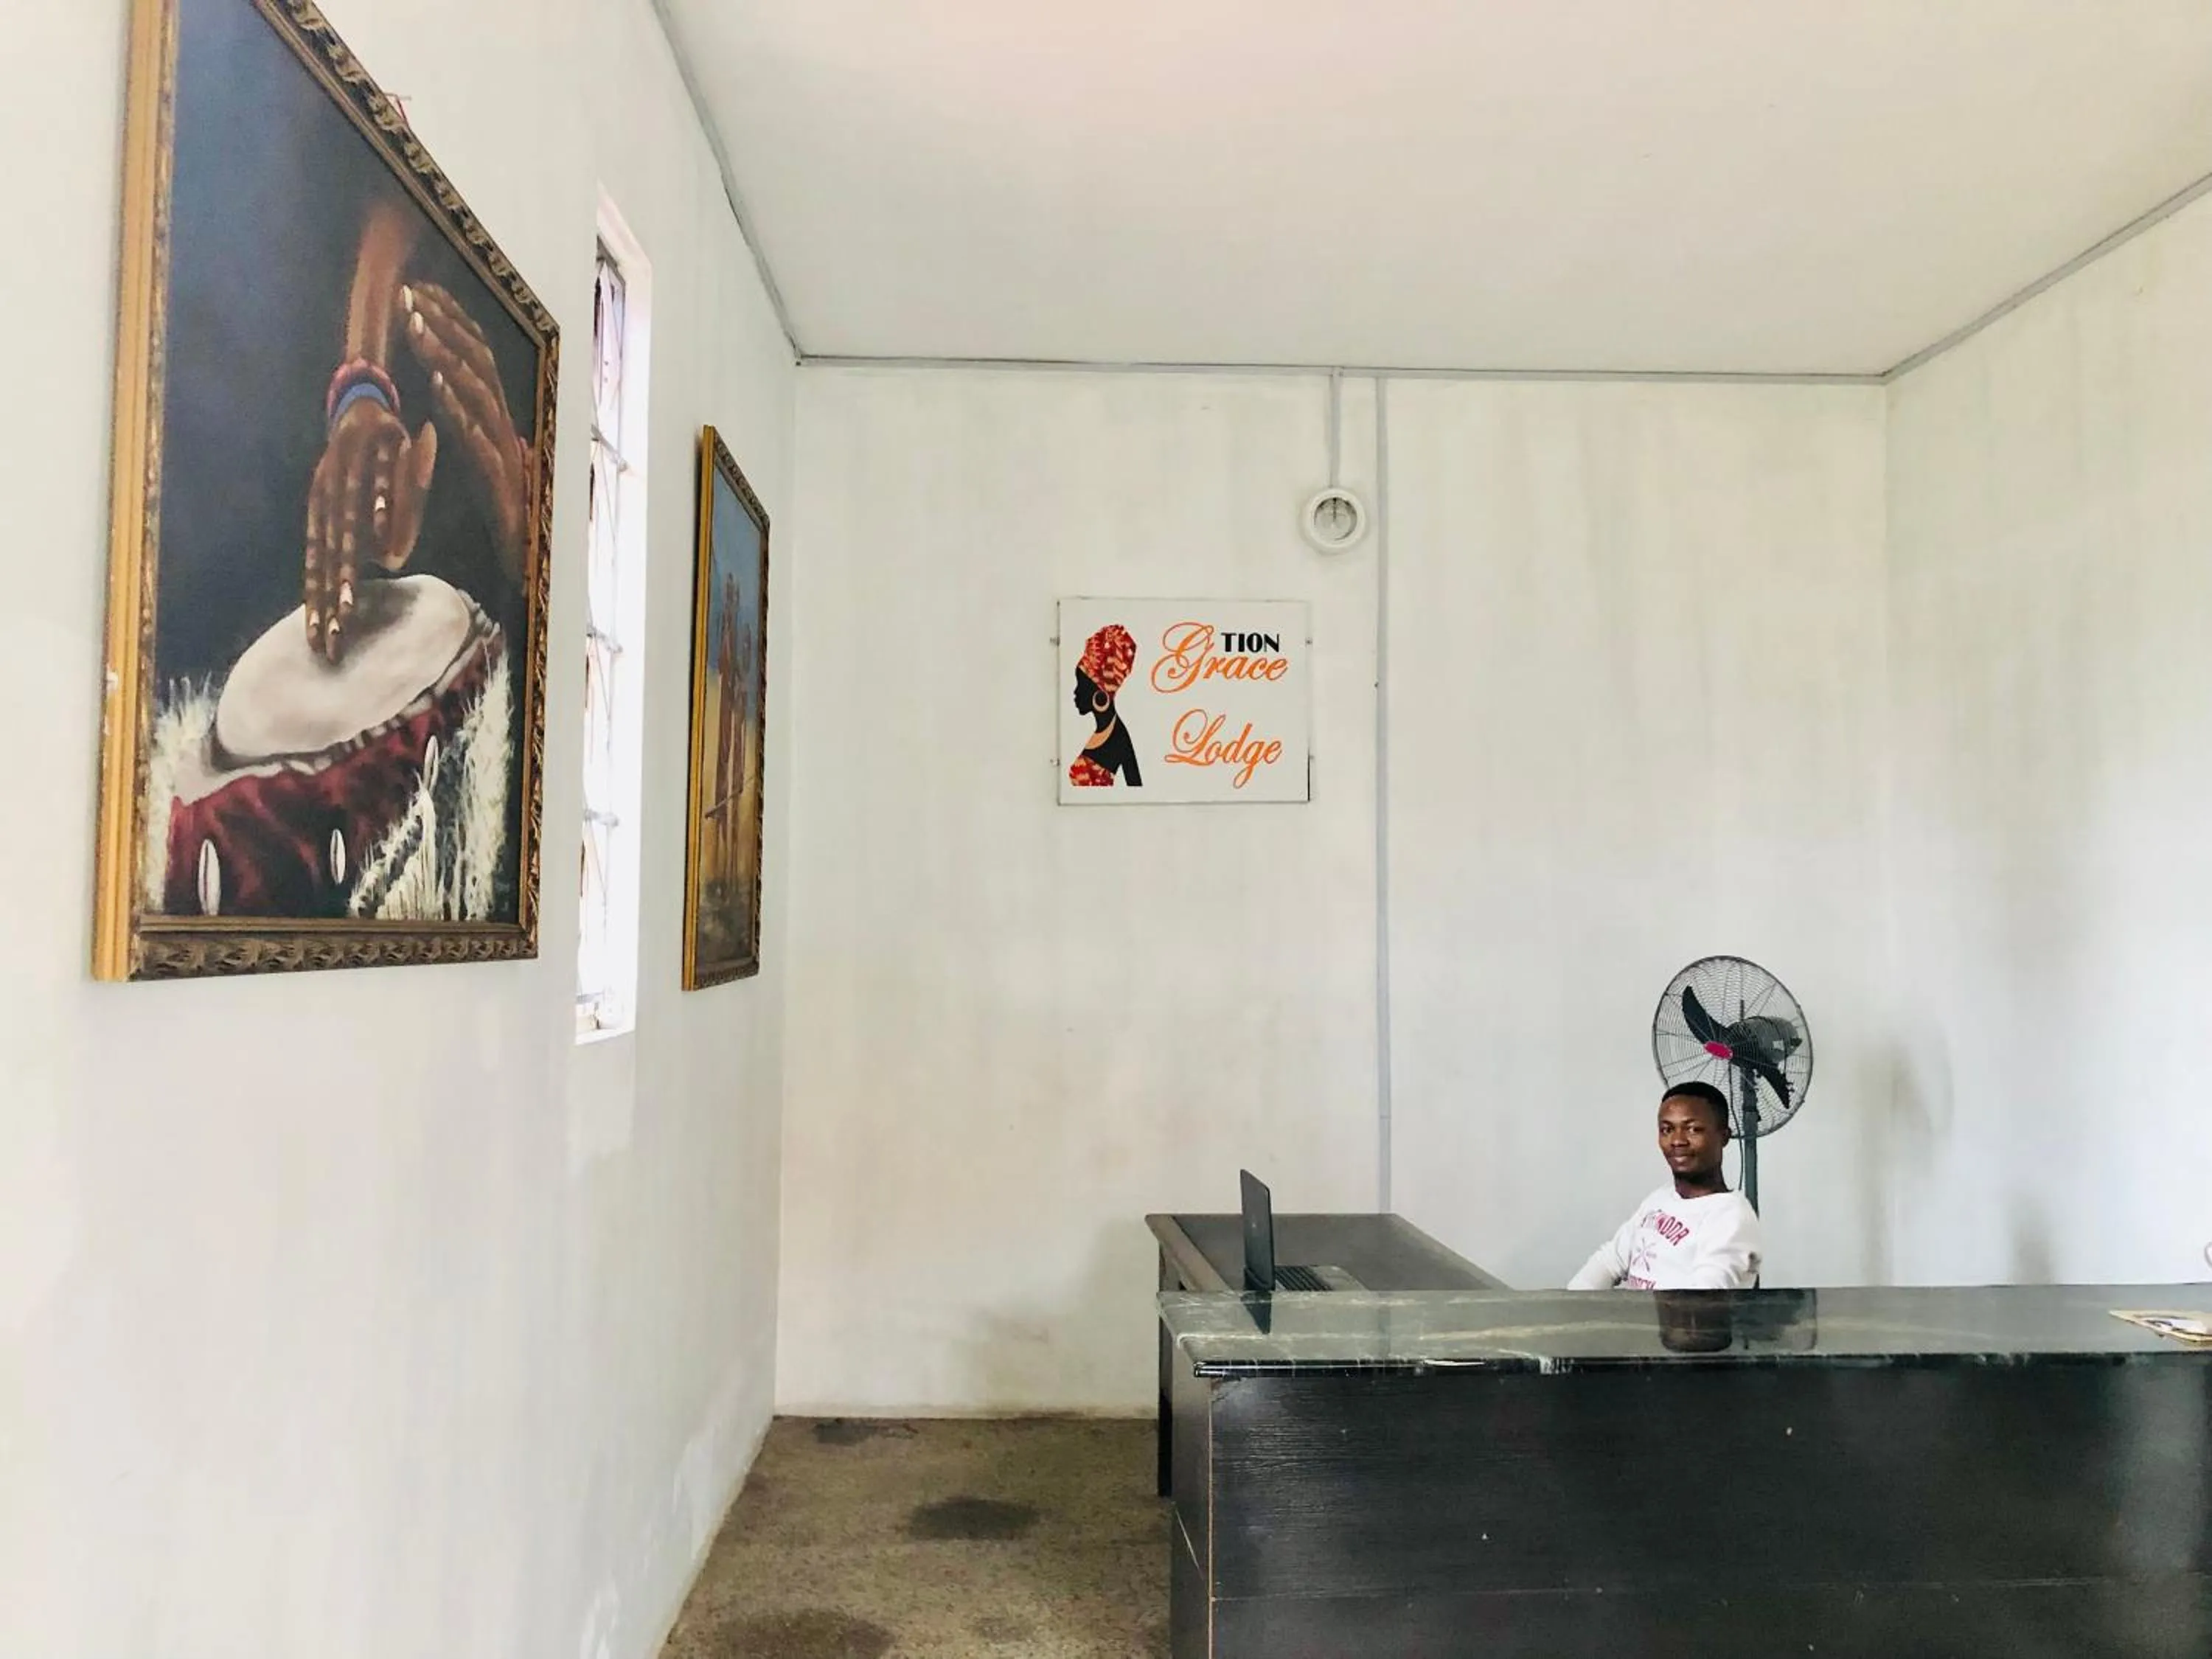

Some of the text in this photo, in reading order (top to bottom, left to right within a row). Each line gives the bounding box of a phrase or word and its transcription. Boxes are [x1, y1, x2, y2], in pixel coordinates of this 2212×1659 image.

[1150, 622, 1289, 693] Grace
[1221, 632, 1279, 653] TION
[1164, 708, 1282, 789] Lodge
